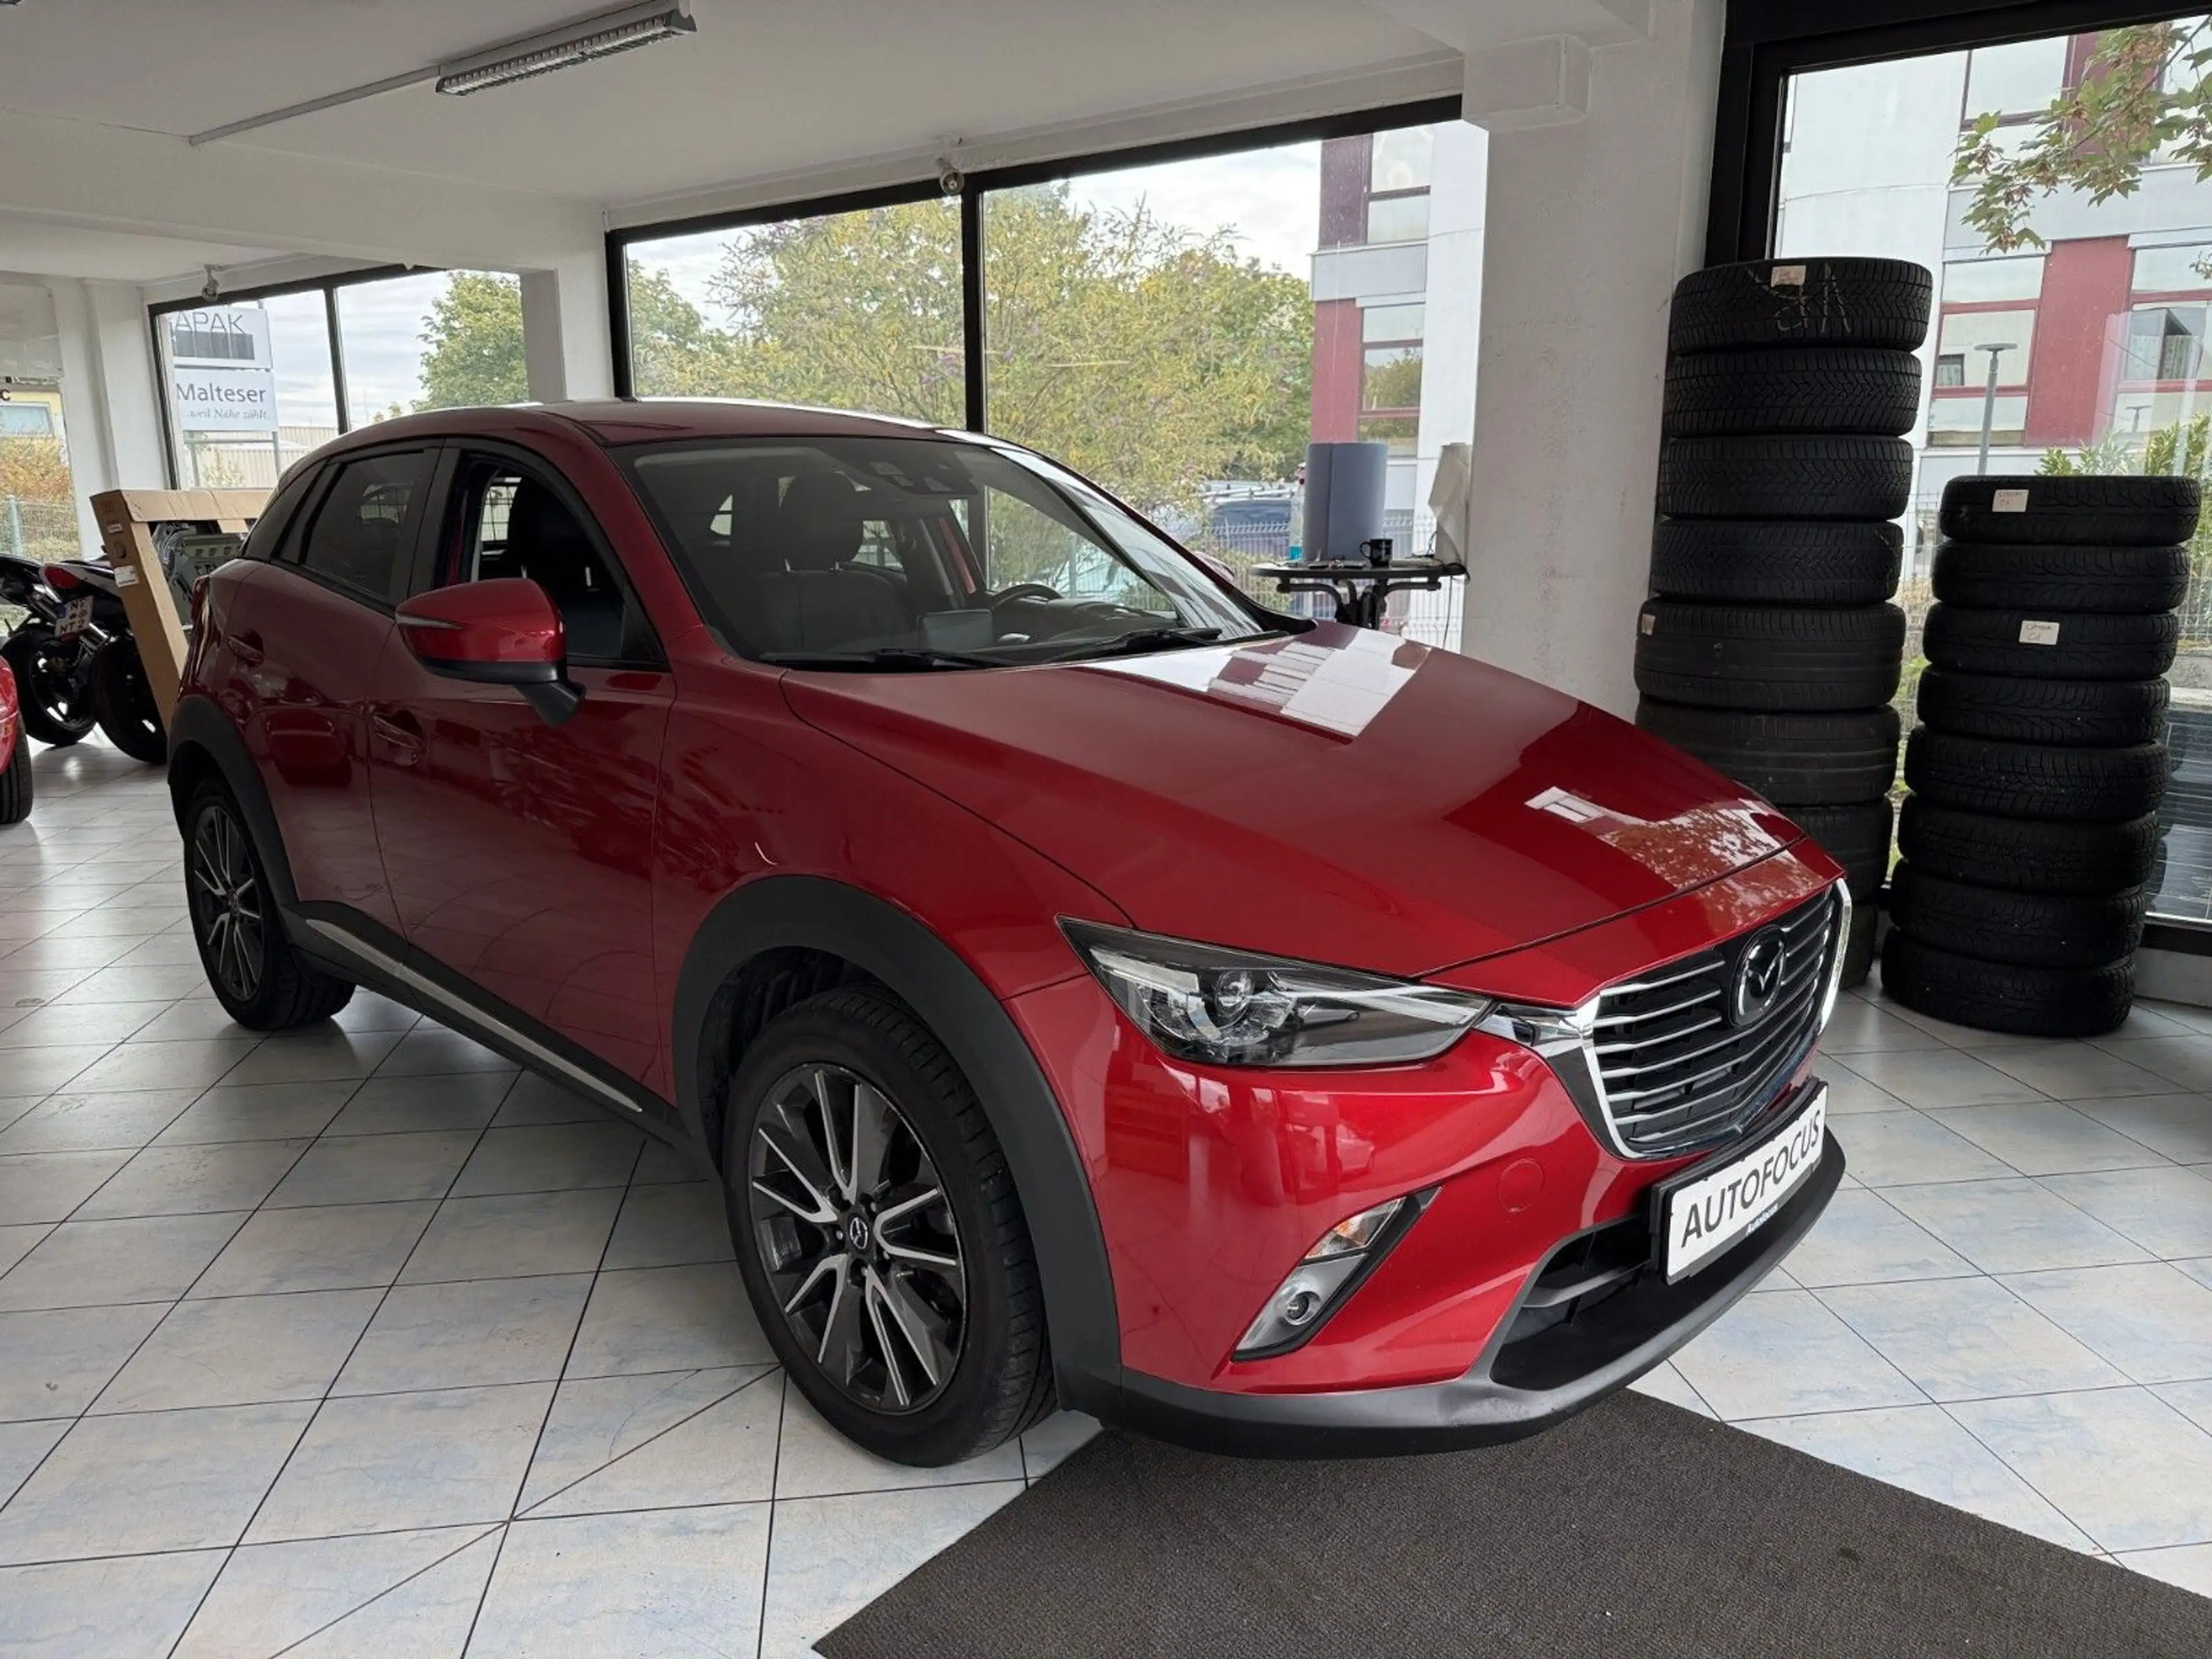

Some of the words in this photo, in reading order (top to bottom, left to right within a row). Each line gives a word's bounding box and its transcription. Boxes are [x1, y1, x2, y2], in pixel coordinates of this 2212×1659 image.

[170, 311, 246, 335] APAK
[176, 382, 267, 403] Malteser
[1681, 1109, 1820, 1248] AUTOFOCUS
